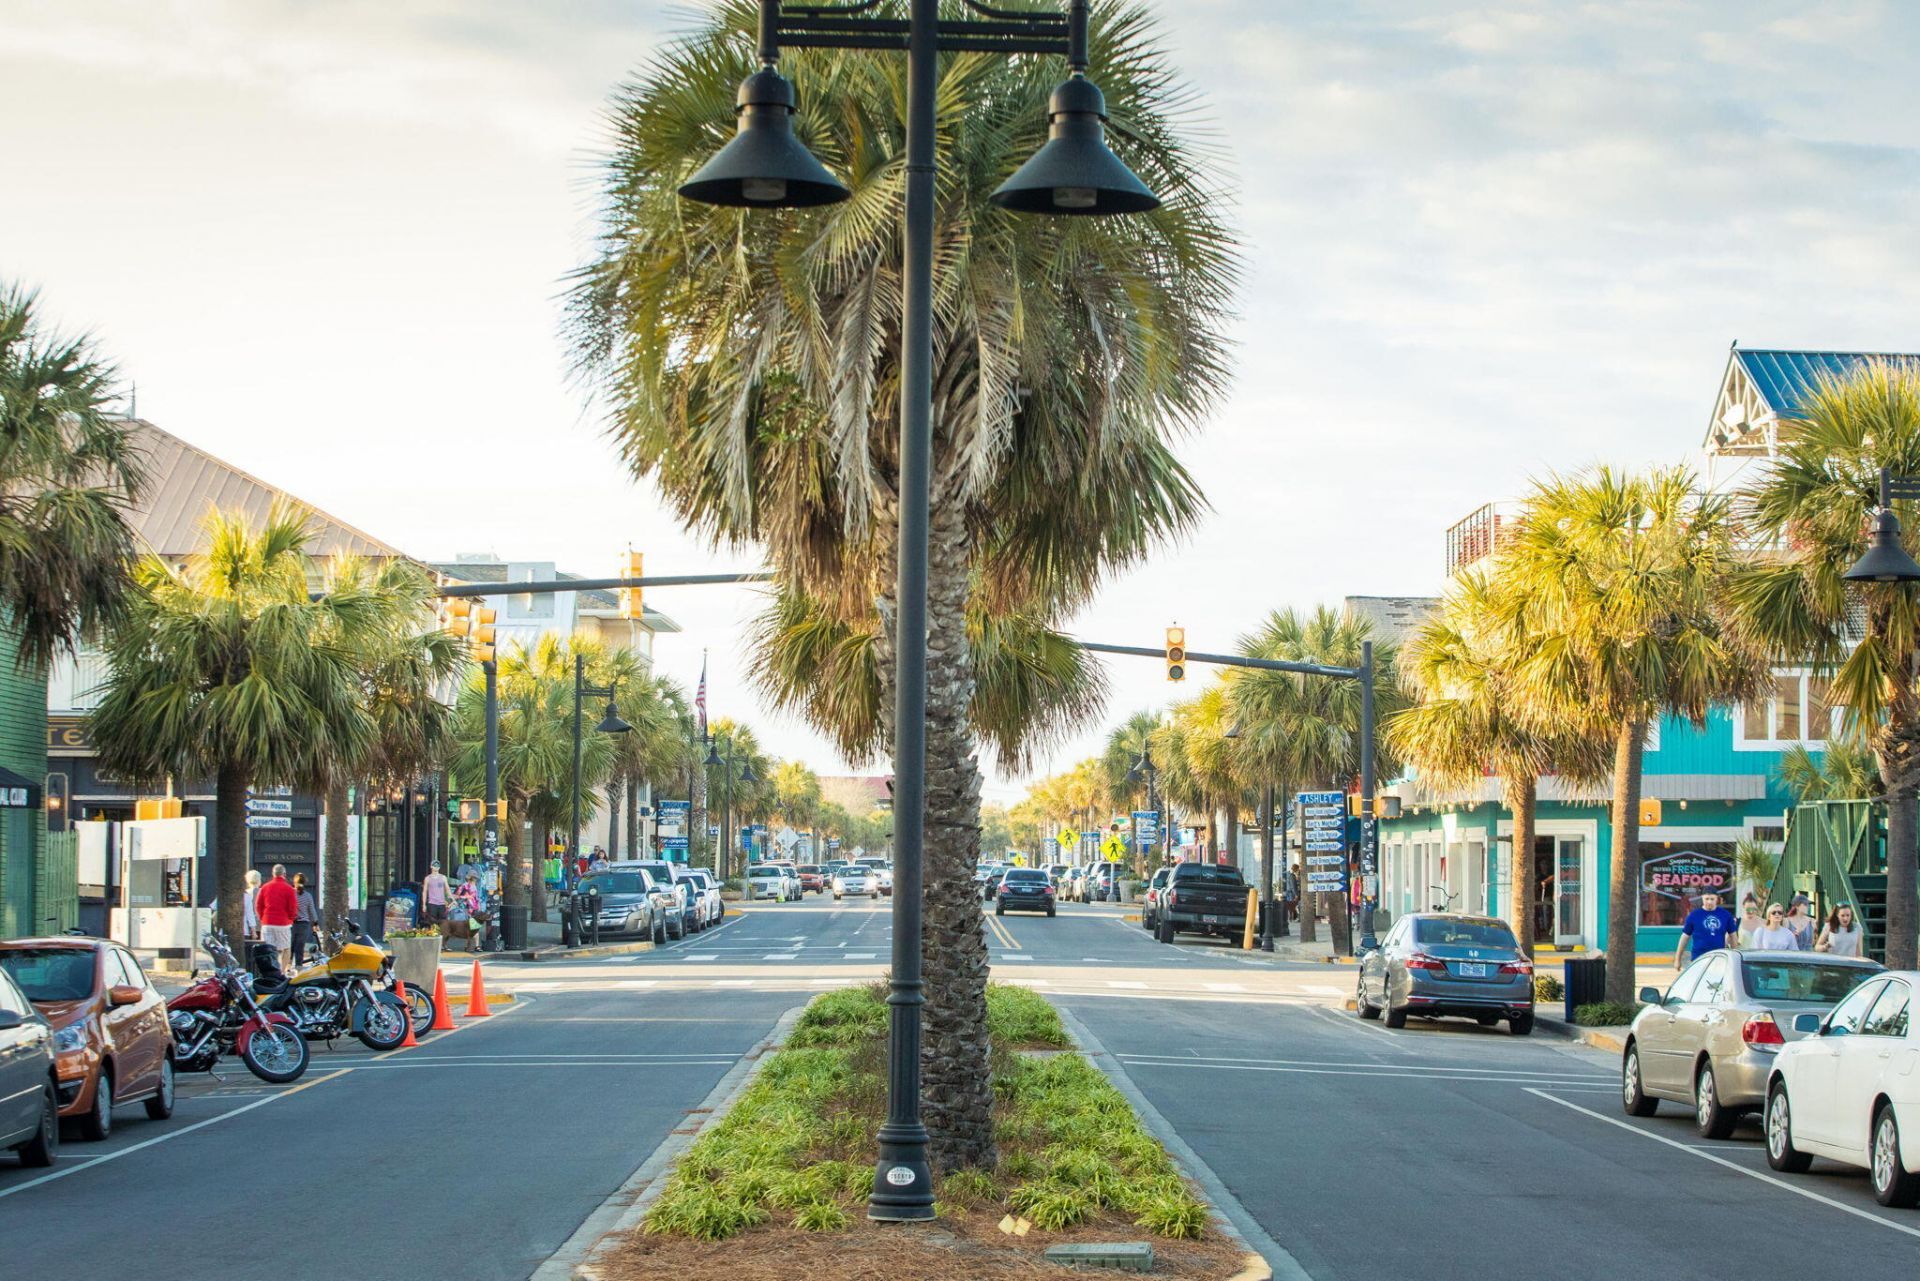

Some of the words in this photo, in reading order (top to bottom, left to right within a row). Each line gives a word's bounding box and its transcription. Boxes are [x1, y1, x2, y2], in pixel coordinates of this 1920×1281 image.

[1305, 794, 1333, 804] ASHLEY
[1672, 865, 1704, 874] FRESH
[1652, 873, 1724, 887] SEAFOOD
